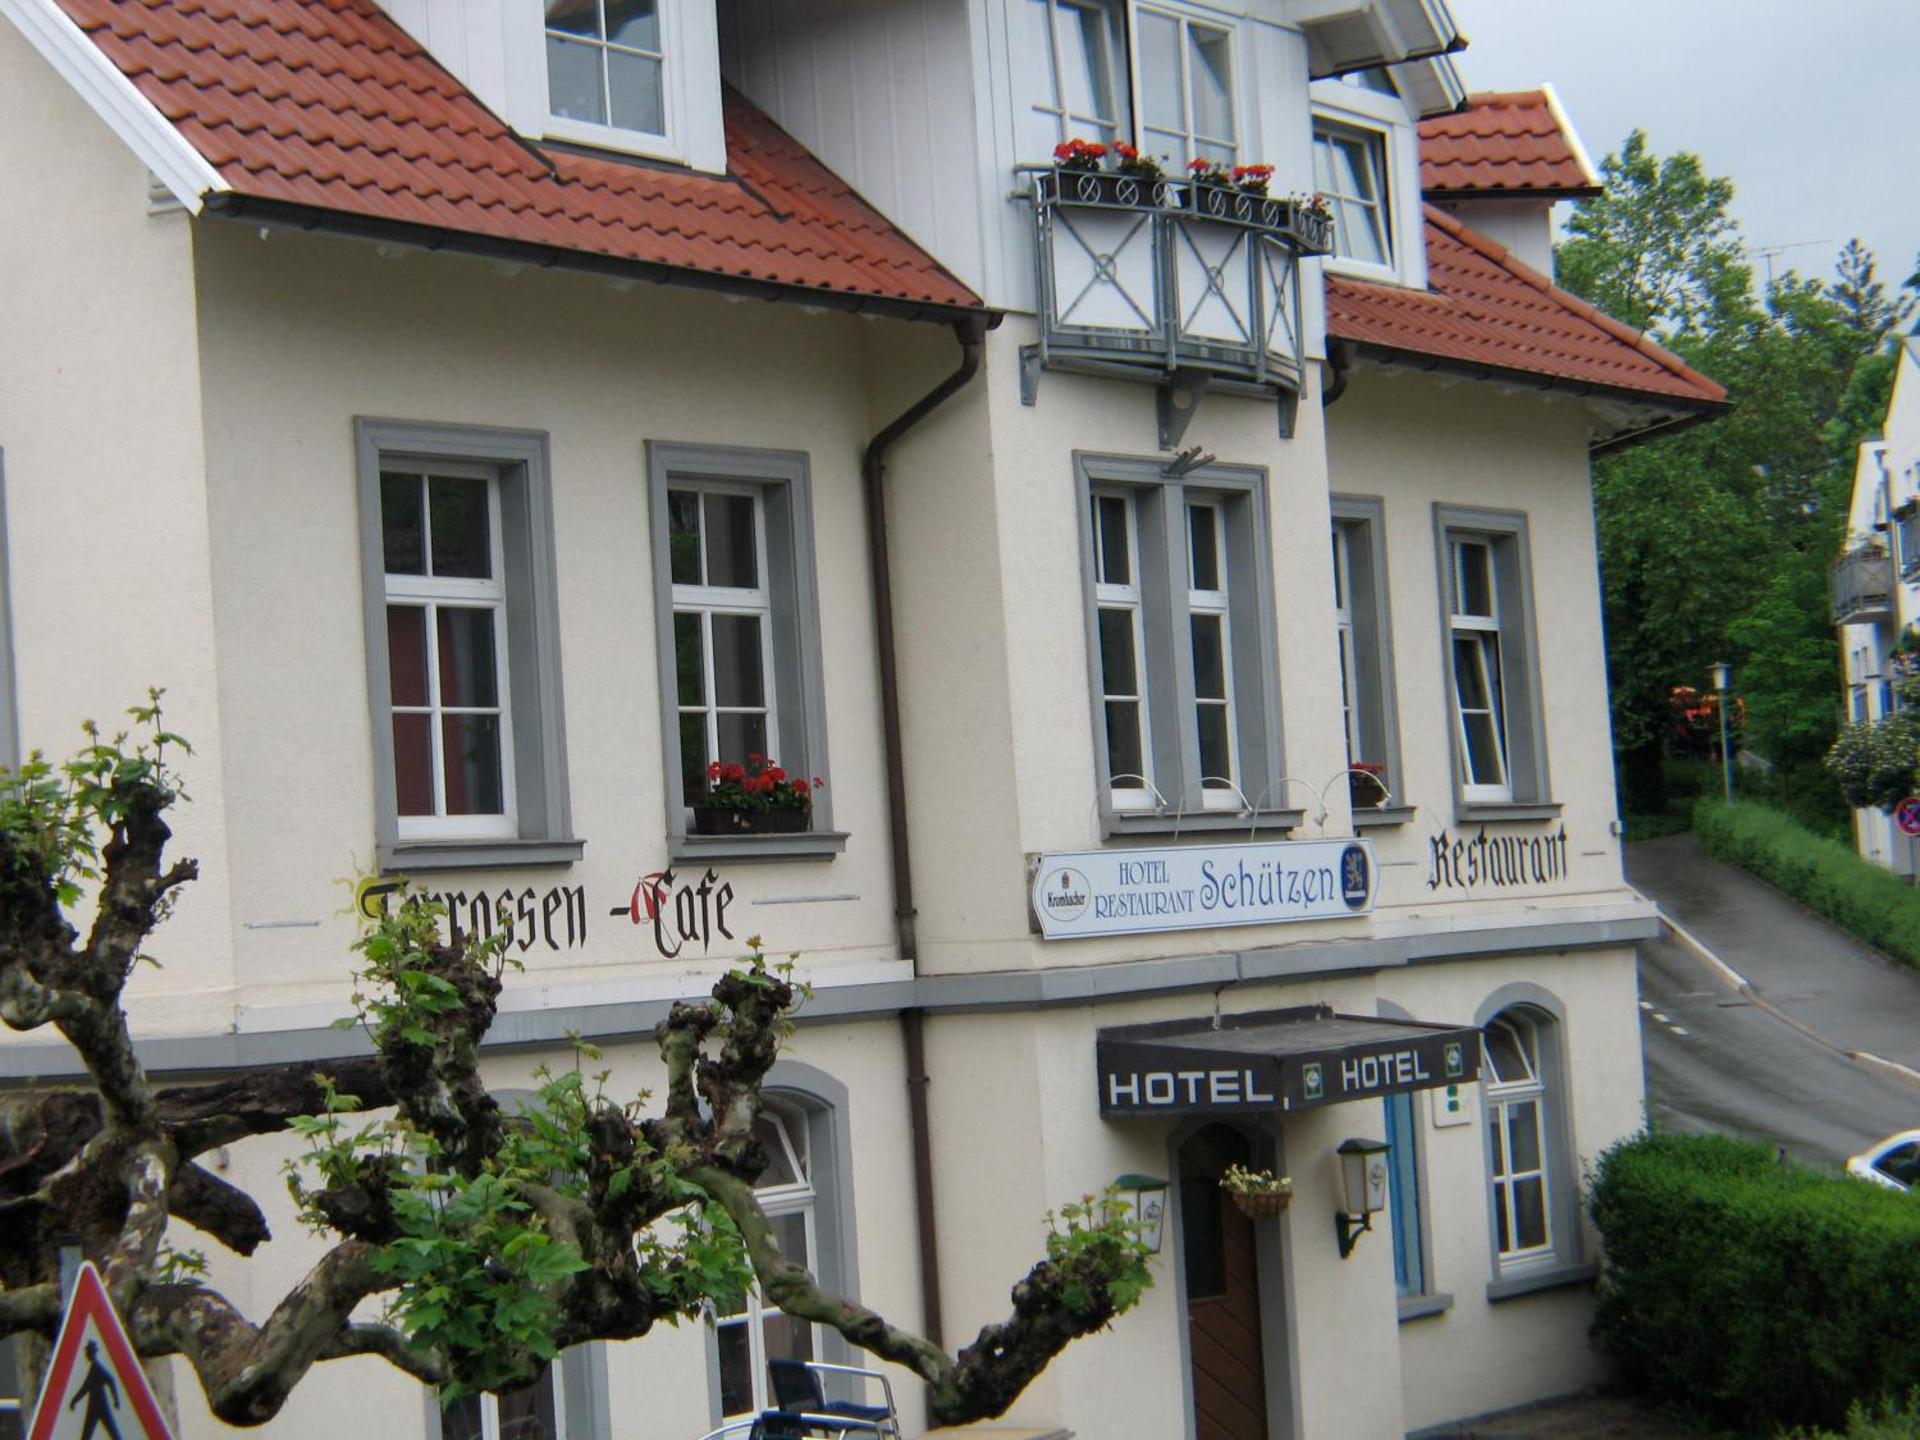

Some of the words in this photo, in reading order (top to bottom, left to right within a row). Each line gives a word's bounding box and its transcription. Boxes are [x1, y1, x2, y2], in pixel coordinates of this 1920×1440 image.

[1118, 860, 1170, 886] HOTEL
[1426, 822, 1568, 891] Restaurant
[1095, 890, 1195, 919] RESTAURANT
[1199, 858, 1335, 910] Schützen
[360, 880, 587, 952] Trassen
[1109, 1069, 1274, 1105] HOTEL
[1341, 1050, 1430, 1092] HOTEL
